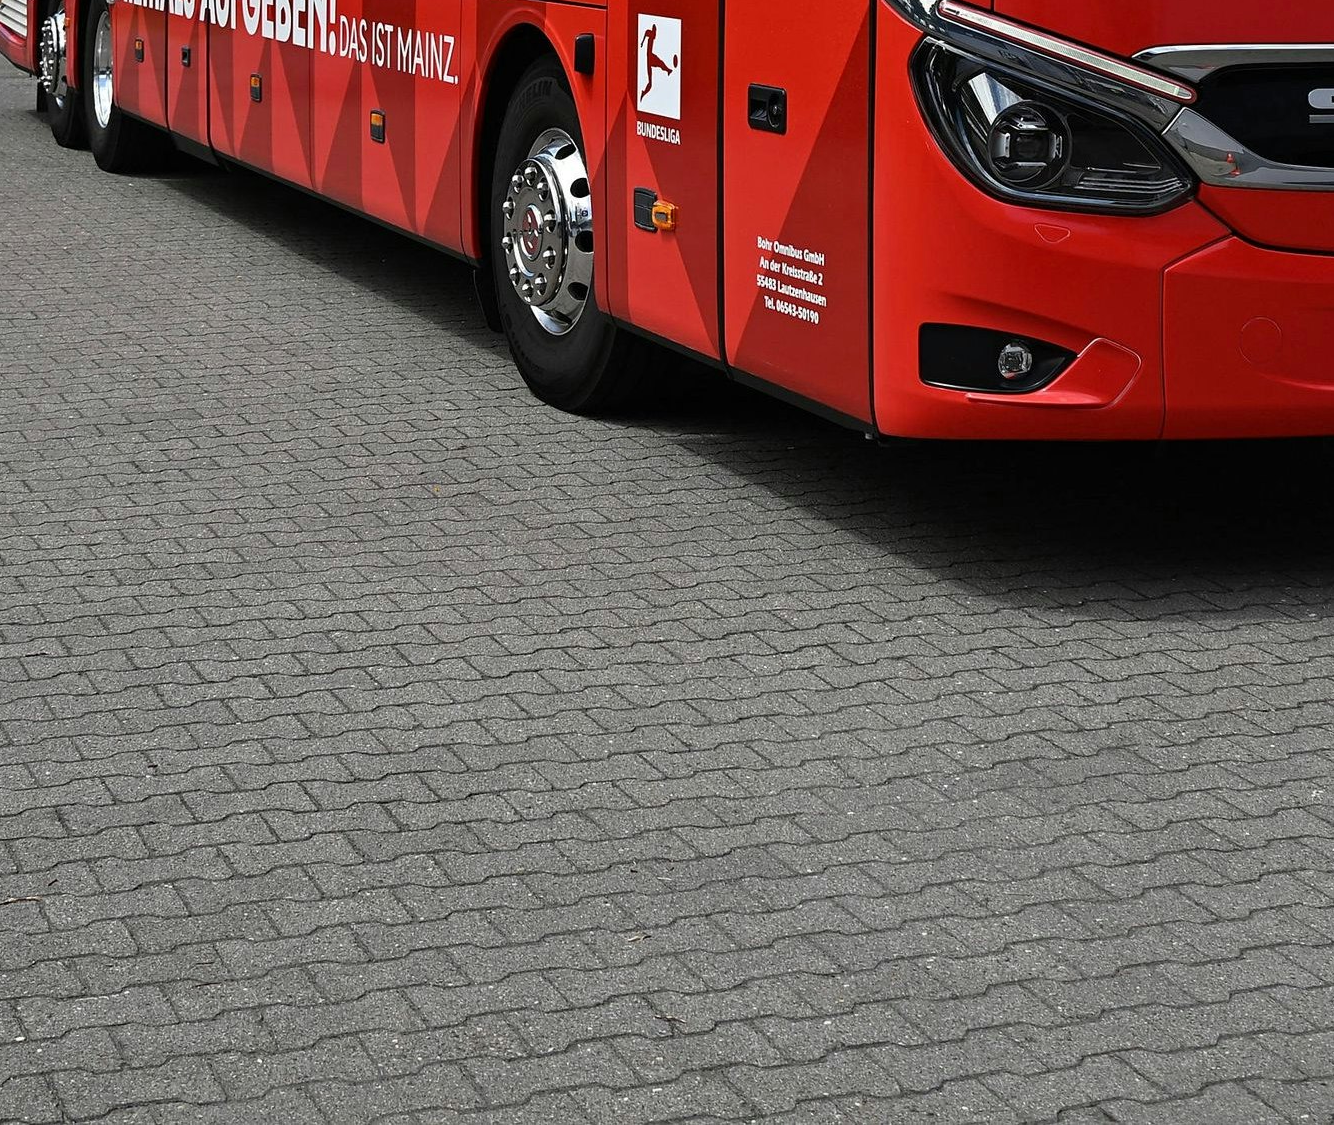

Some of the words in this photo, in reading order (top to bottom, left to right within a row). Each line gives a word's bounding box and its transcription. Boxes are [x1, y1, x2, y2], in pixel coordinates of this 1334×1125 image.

[339, 15, 368, 63] DAS
[372, 22, 393, 69] IST
[397, 27, 459, 85] MAINZ.
[637, 120, 681, 145] BUNDESLIGA
[757, 236, 773, 251] Bohr
[774, 241, 803, 260] Omnibus
[803, 249, 825, 266] GmbH
[759, 256, 769, 270] An
[770, 259, 781, 273] der
[782, 262, 818, 285] Kreisstraße
[818, 273, 823, 286] 2
[757, 274, 776, 291] 55483
[778, 281, 827, 307] Lautzenhausen
[764, 295, 775, 310] Tel.
[776, 299, 819, 324] 06543-50190
